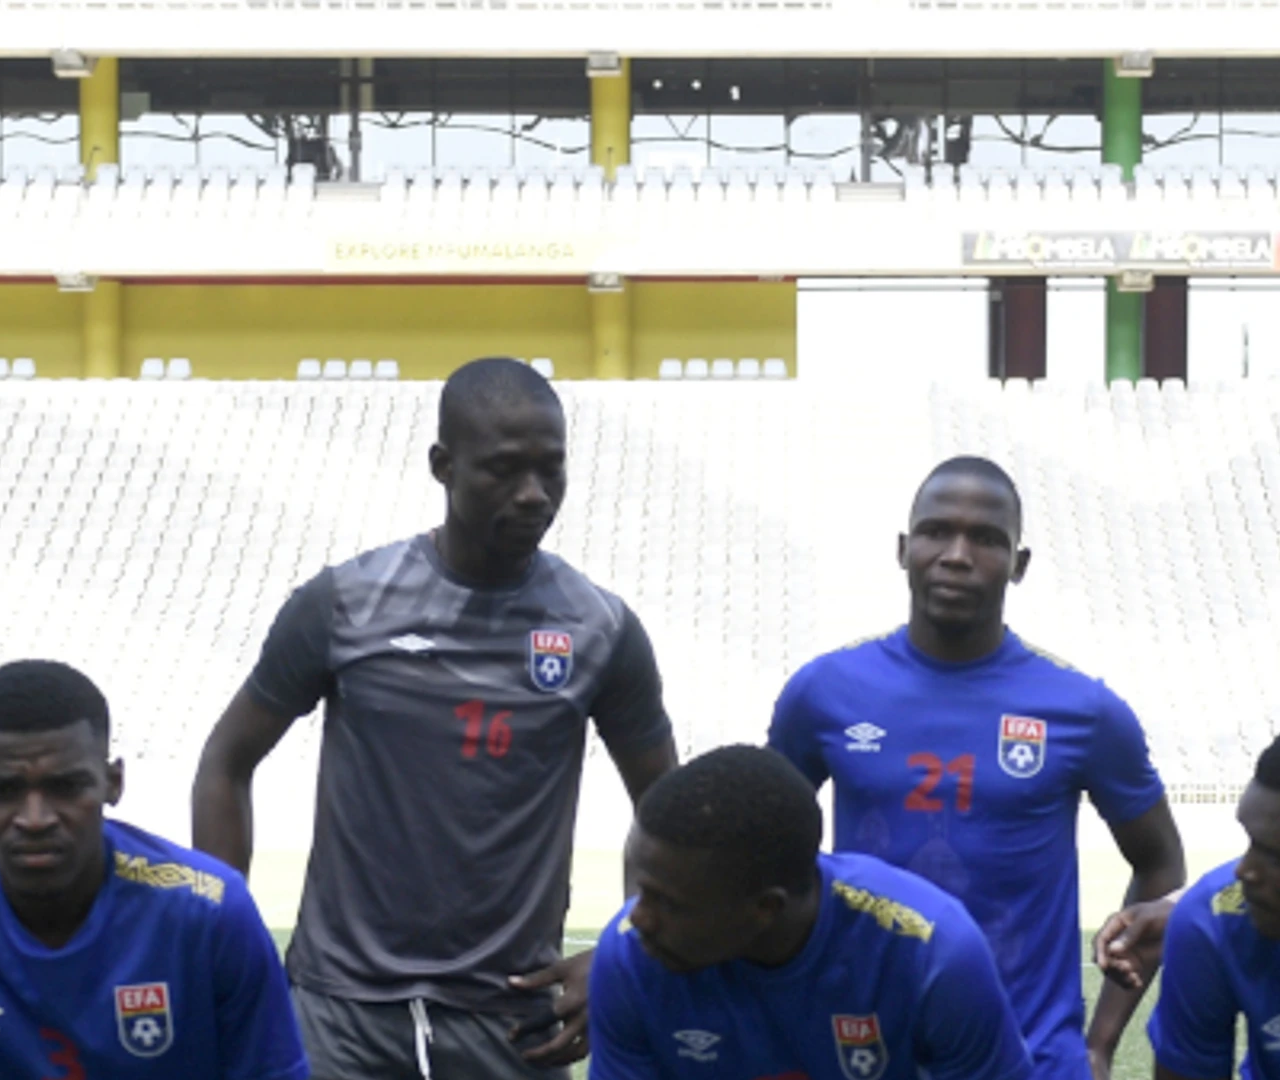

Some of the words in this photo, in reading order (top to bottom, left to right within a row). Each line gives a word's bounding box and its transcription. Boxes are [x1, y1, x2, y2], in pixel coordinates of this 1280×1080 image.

[538, 634, 568, 651] EFA
[454, 699, 513, 759] 16
[1008, 719, 1038, 738] EFA
[904, 752, 975, 812] 21
[124, 990, 161, 1008] EFA
[841, 1022, 872, 1039] EFA
